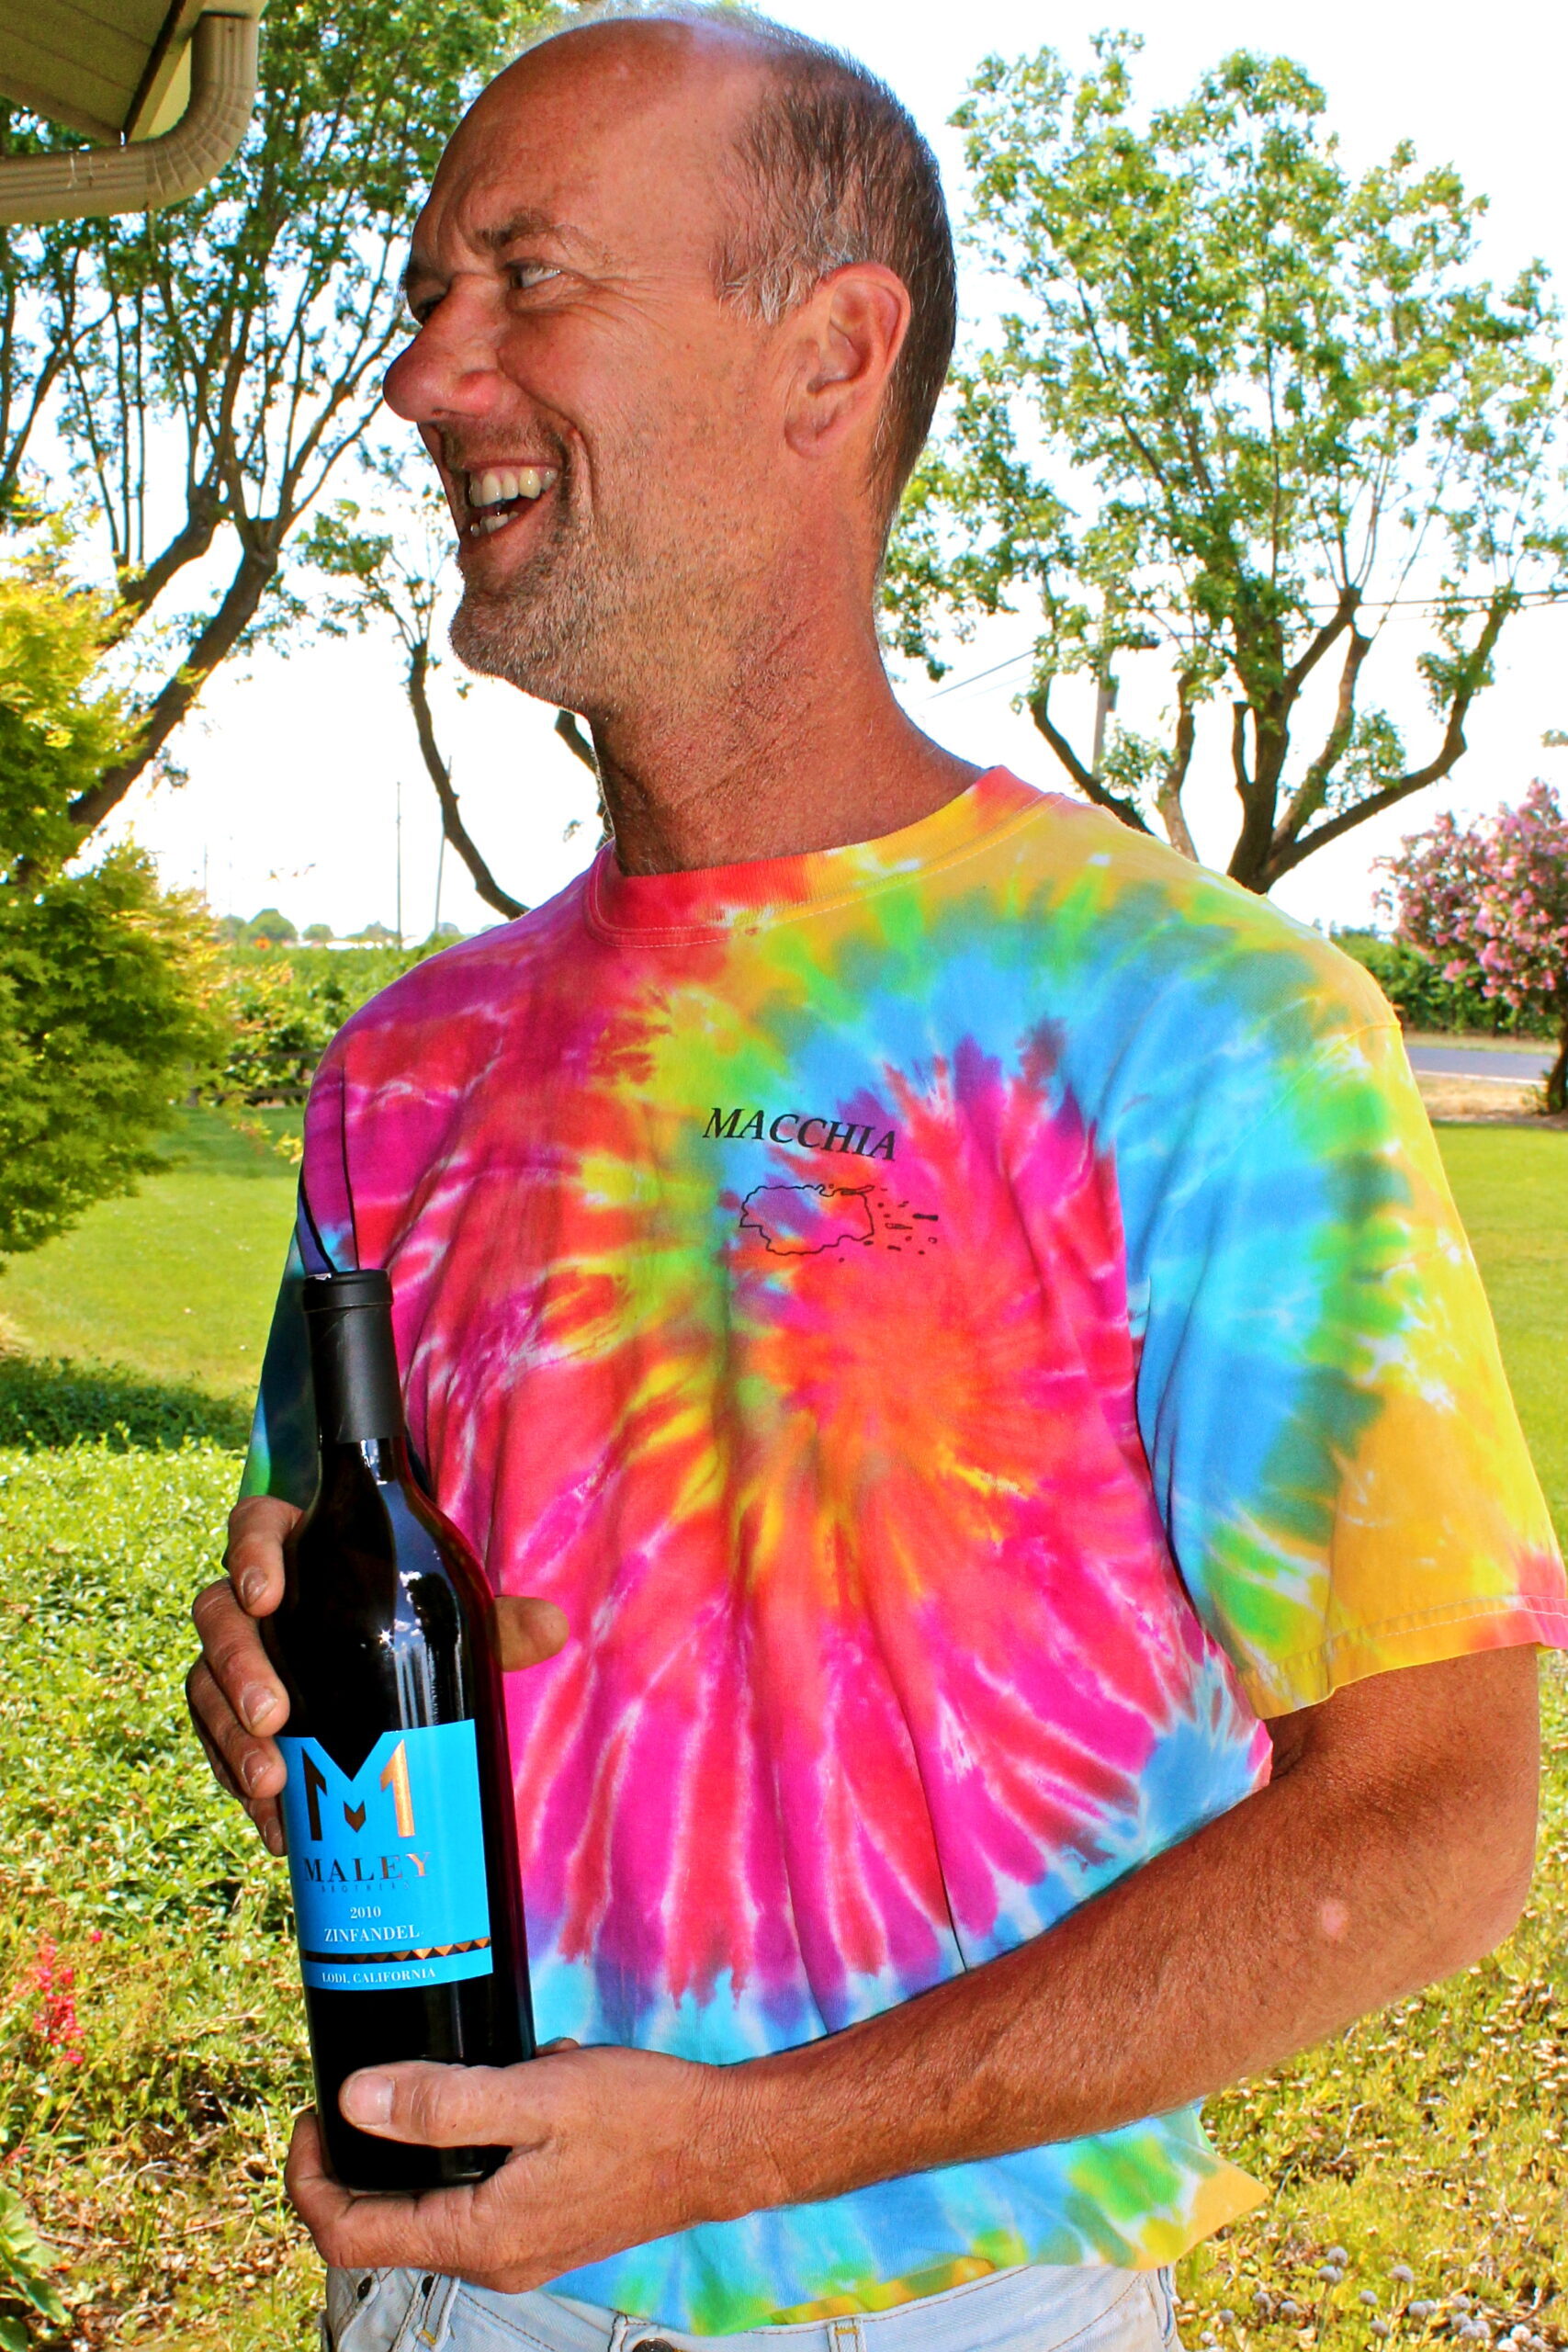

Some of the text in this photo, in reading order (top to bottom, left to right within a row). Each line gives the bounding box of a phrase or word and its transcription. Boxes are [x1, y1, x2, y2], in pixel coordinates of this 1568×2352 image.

[702, 1107, 896, 1161] MACCHIA
[302, 1852, 431, 1882] MALEY
[350, 1905, 381, 1918] 2010
[324, 1925, 420, 1942] ZINFANDEL
[353, 1967, 436, 1984] CALIFORNIA
